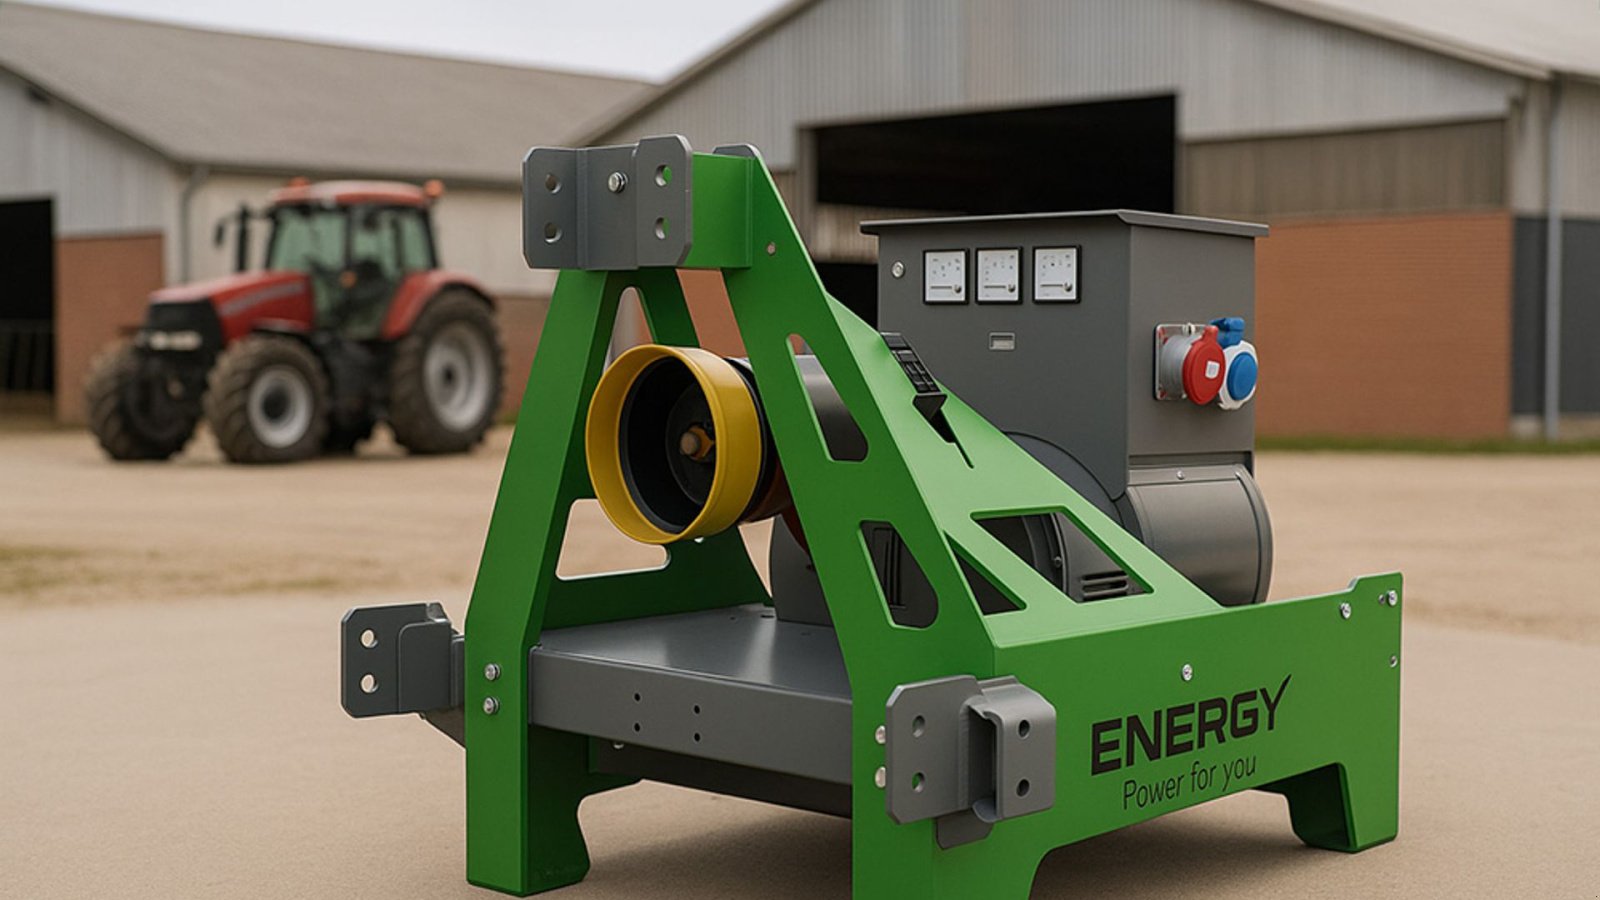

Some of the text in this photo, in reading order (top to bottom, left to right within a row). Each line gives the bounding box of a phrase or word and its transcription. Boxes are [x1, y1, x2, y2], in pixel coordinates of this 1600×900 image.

[1091, 674, 1292, 776] ENERGY
[1123, 756, 1257, 810] Power for you
